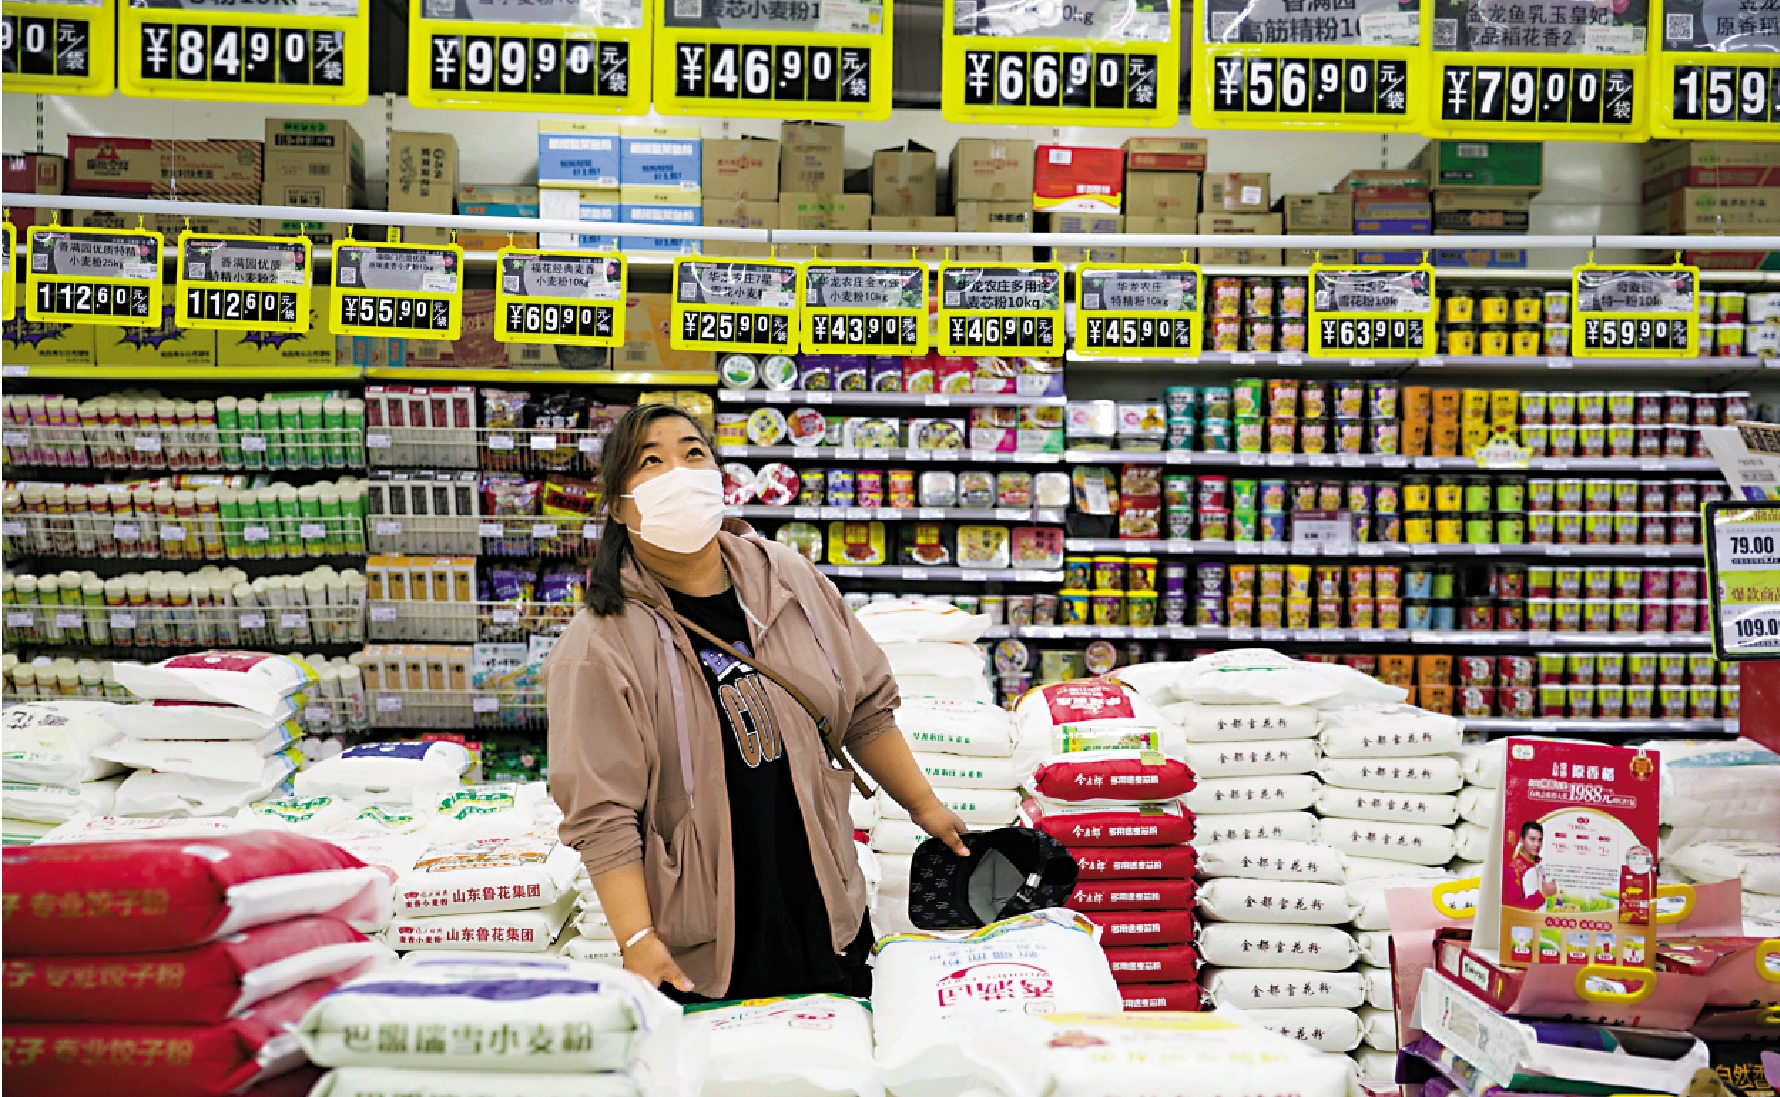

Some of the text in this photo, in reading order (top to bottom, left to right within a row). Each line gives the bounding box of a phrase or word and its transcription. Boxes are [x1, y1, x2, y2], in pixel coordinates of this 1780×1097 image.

[144, 28, 302, 75] ¥84.90
[434, 38, 588, 85] ¥99.90
[680, 47, 830, 93] ¥46.90
[968, 54, 1117, 99] ¥66.90
[1217, 58, 1366, 106] ¥56.90
[1448, 71, 1597, 114] ¥79.00
[40, 285, 126, 310] 112.60
[189, 291, 276, 317] 112.60
[346, 299, 427, 322] ¥55.90
[511, 305, 591, 330] ¥69.90
[685, 313, 768, 338] ¥25.90
[815, 316, 896, 341] ¥43.90
[953, 319, 1033, 342] ¥46.90
[1090, 320, 1170, 343] ¥45.90
[1322, 320, 1404, 346] ¥63.90
[1586, 320, 1666, 345] ¥59.90
[1730, 536, 1774, 554] 79.00
[1736, 618, 1780, 638] 109.0
[453, 883, 540, 903] 山东鲁花集团
[446, 926, 534, 943] 山东鲁花集团
